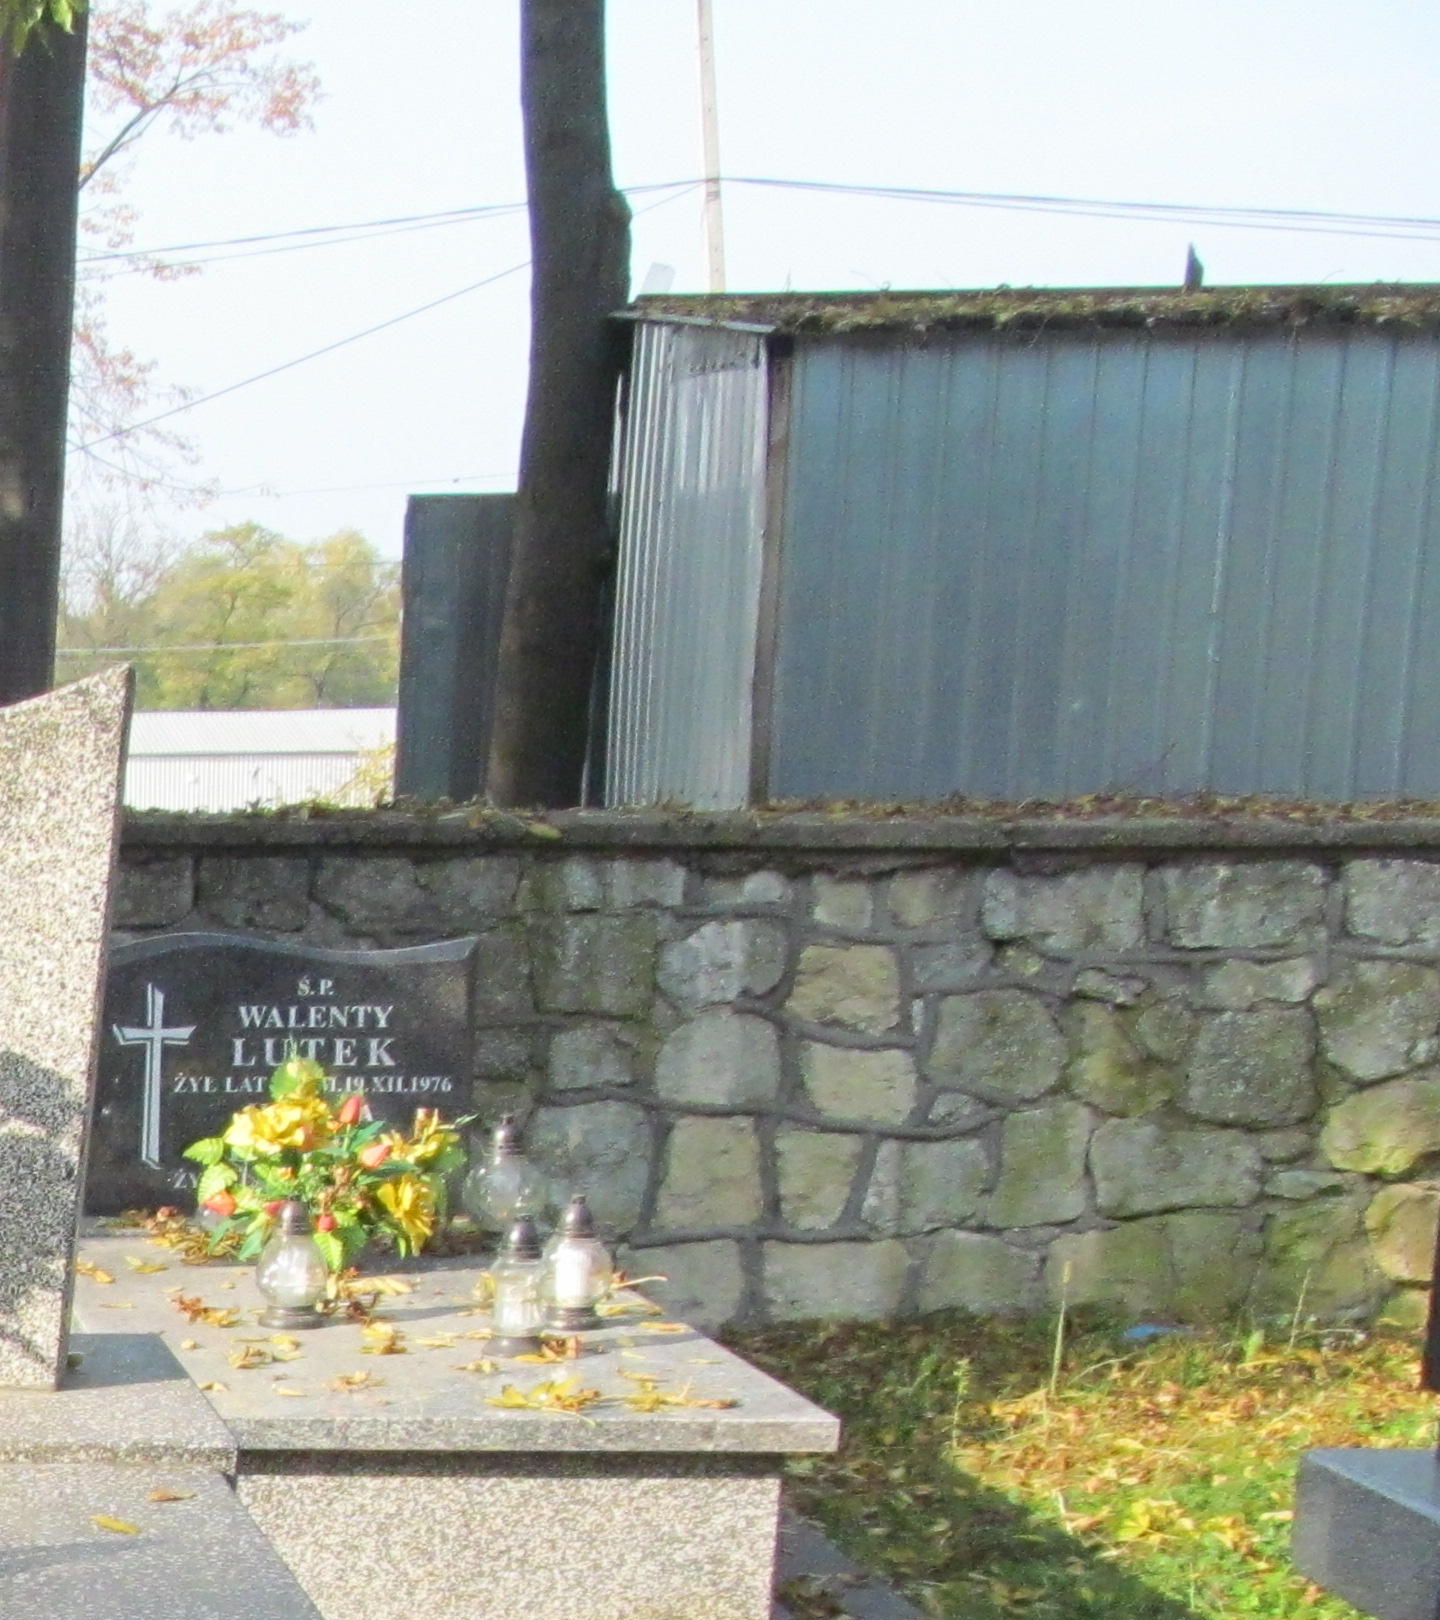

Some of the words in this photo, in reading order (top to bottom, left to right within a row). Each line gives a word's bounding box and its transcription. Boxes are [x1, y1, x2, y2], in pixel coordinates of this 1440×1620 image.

[239, 1006, 394, 1029] WALENTY
[232, 1038, 396, 1067] LUTEK
[174, 1073, 218, 1094] ŻYŁ
[224, 1077, 267, 1094] LAT
